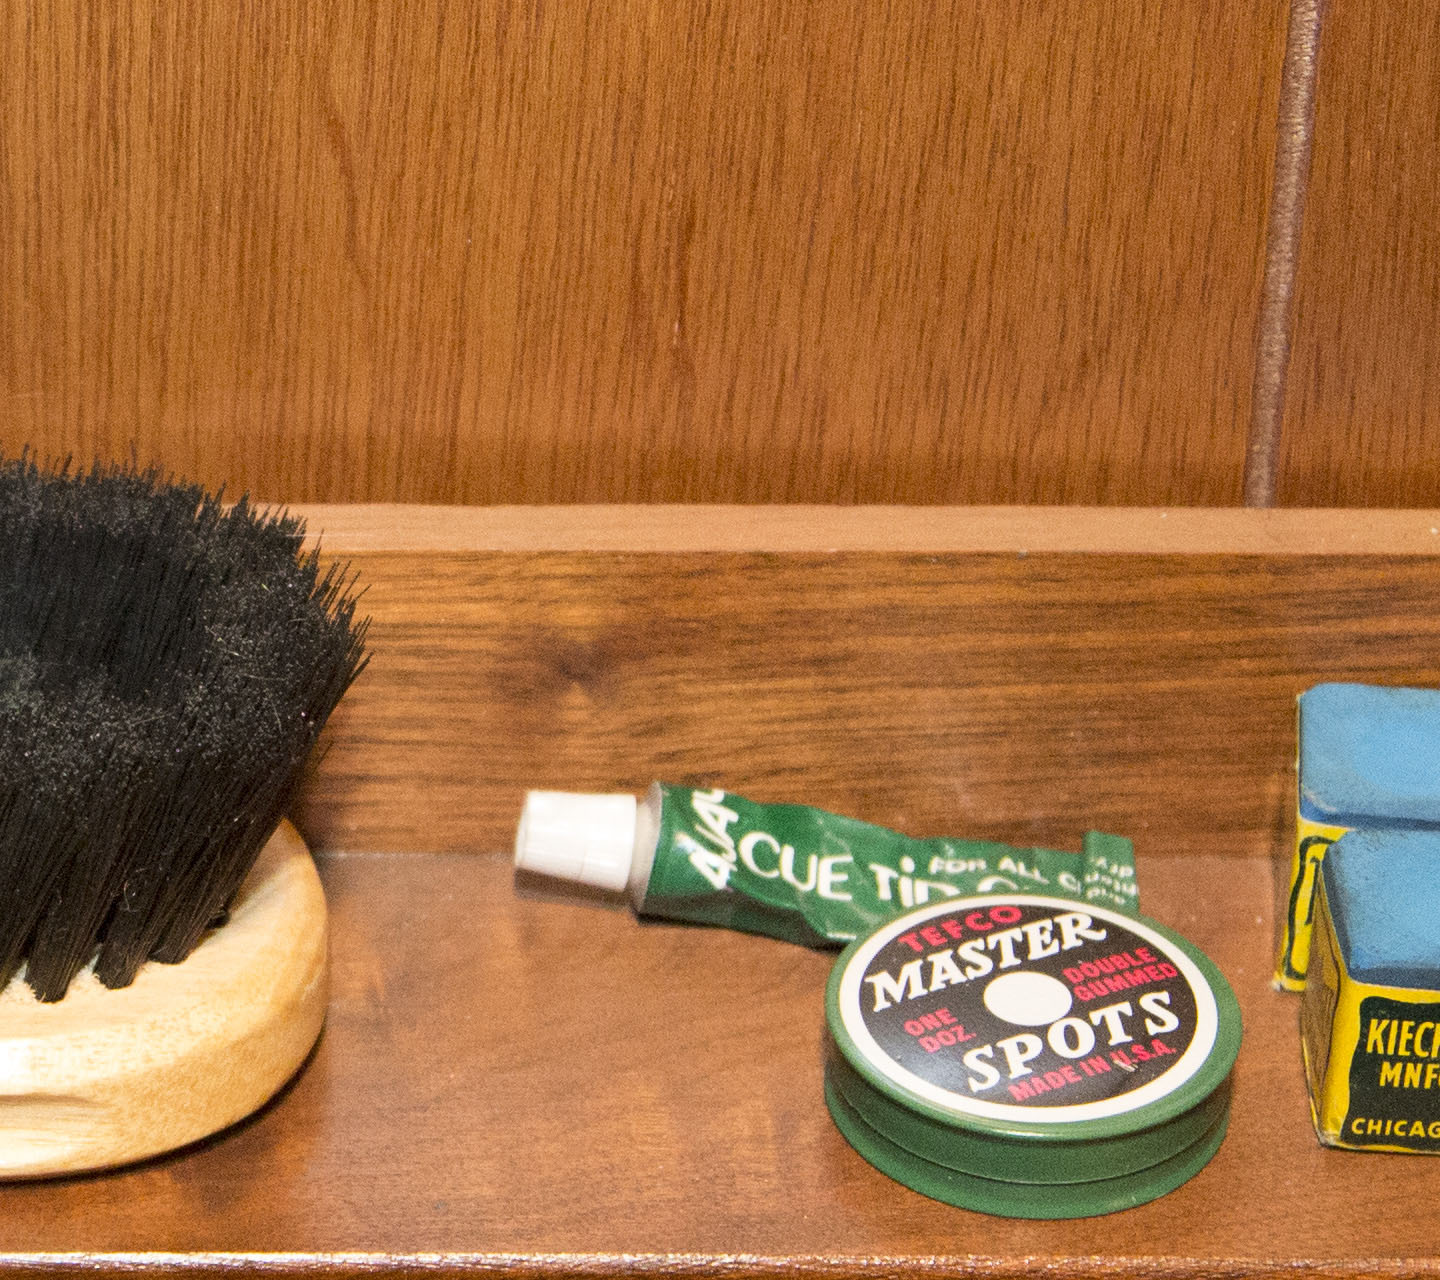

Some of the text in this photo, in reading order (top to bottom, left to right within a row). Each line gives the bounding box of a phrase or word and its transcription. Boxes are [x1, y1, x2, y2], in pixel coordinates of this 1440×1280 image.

[739, 831, 852, 901] CUE
[929, 855, 987, 875] FOR
[998, 855, 1050, 885] ALL
[898, 905, 1022, 953] TEFCO
[864, 911, 1108, 1012] MASTER
[1062, 947, 1158, 984] DOUBLE
[1073, 963, 1178, 1002] GUMMED
[903, 1008, 958, 1037] ONE
[919, 1024, 977, 1054] DOZ.
[962, 991, 1180, 1093] SPOTS
[1007, 1063, 1083, 1102] MADE
[1079, 1055, 1111, 1077] IN
